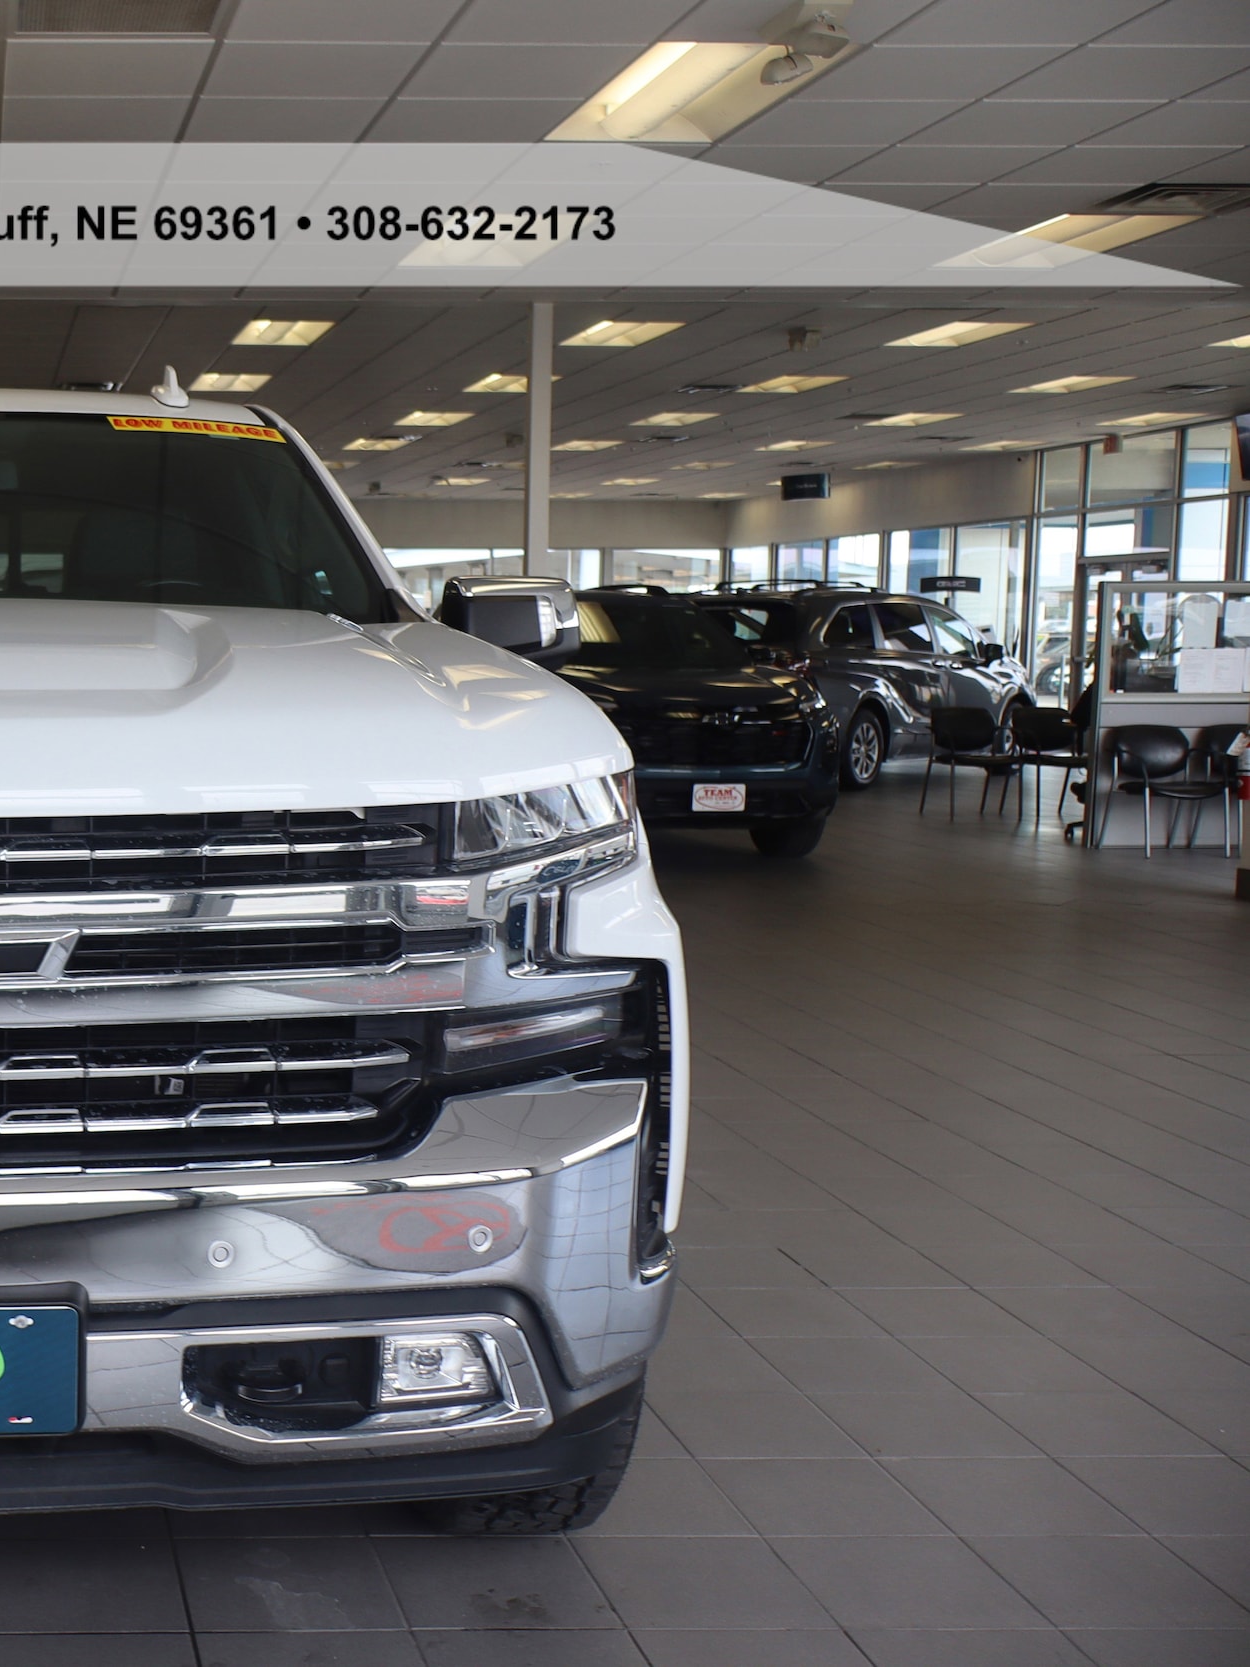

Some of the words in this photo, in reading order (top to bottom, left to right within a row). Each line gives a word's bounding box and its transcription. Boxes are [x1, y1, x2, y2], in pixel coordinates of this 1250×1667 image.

[111, 417, 163, 429] LOW
[170, 419, 279, 439] MILEAGE
[704, 789, 733, 797] TEAM
